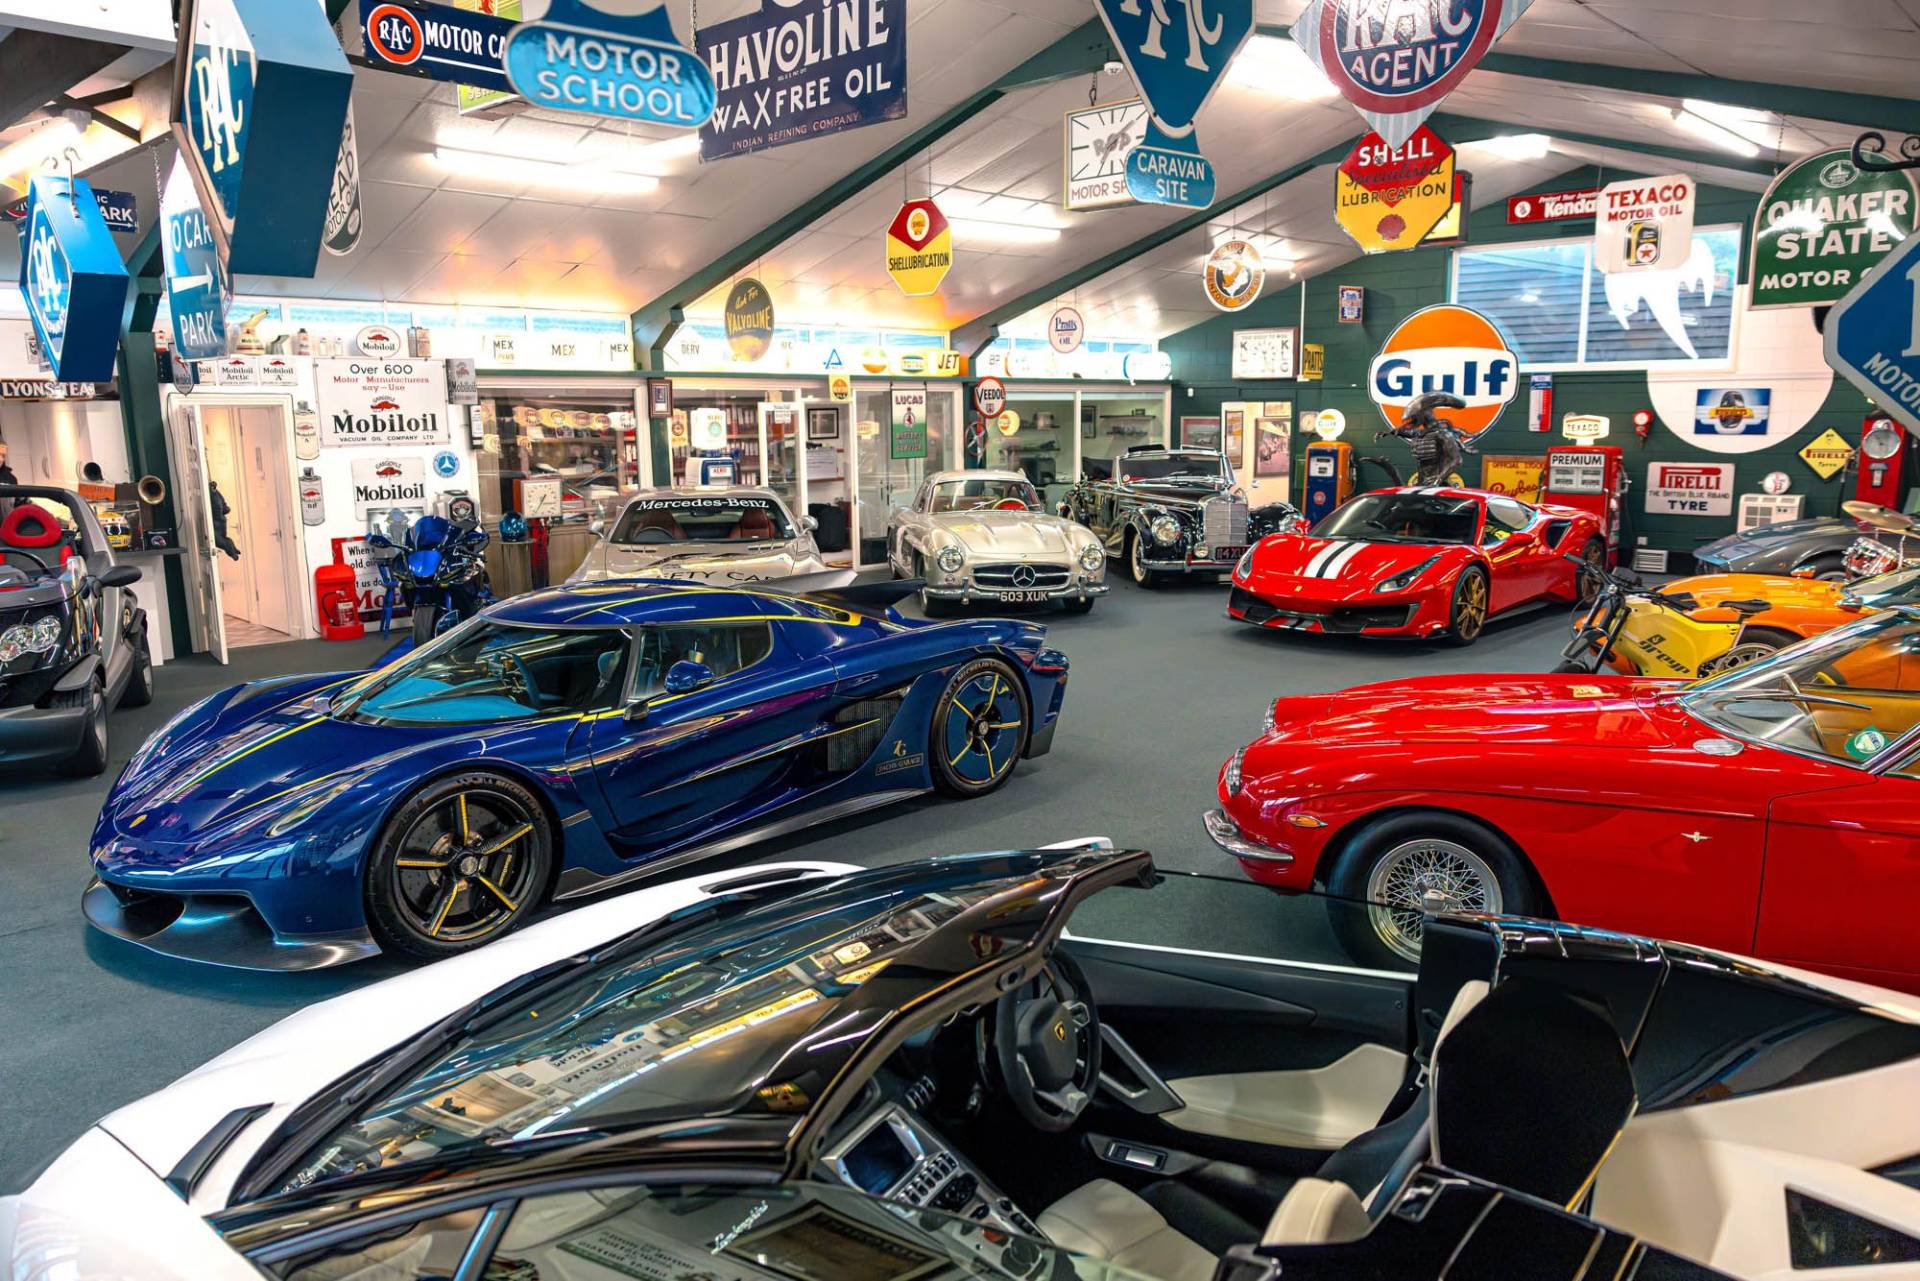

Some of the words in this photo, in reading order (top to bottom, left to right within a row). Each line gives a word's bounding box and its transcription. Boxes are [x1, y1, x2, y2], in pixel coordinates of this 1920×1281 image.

[378, 18, 412, 51] RAC
[425, 20, 483, 55] MOTOR
[708, 0, 890, 91] HAVOLINE
[545, 32, 680, 84] MOTOR
[1350, 41, 1459, 88] AGENT
[845, 62, 892, 99] OIL
[537, 70, 693, 121] SCHOOL
[195, 38, 243, 173] RAC
[732, 135, 763, 151] INDIAN
[768, 124, 808, 142] REFINING
[812, 112, 860, 131] COMPANY
[1358, 137, 1433, 166] SHELL
[1137, 152, 1205, 181] CARAVAN
[1071, 183, 1108, 201] MOTOR
[1156, 178, 1188, 201] SITE
[1342, 182, 1446, 207] LUBRICATION
[1606, 184, 1687, 208] TEXACO
[100, 206, 133, 222] ARK
[1543, 199, 1598, 219] Kenda
[1608, 208, 1654, 221] MOTOR
[1659, 204, 1682, 217] OIL
[1767, 189, 1909, 228] QUAKER
[1776, 227, 1892, 260] STATE
[889, 252, 950, 272] SHELLUBRICATION
[1759, 269, 1851, 290] MOTOR
[179, 310, 218, 346] PARK
[726, 305, 771, 336] VALVOLINE
[362, 342, 395, 351] Mobiloil
[493, 340, 513, 350] MEX
[552, 344, 575, 356] MEX
[610, 343, 629, 352] MEX
[222, 366, 253, 374] Mobiloil
[263, 366, 293, 375] Mobiloil
[350, 364, 378, 375] Over
[384, 364, 413, 375] 600
[938, 354, 959, 370] JET
[333, 376, 359, 384] Motor
[366, 376, 429, 384] Manufacturers
[1376, 358, 1509, 397] Gulf
[62, 382, 95, 397] TEA
[976, 388, 1005, 407] VEEDOL
[895, 395, 923, 405] LUCAS
[332, 413, 438, 434] Mobiloil
[1567, 423, 1599, 433] TEXACO
[1552, 455, 1602, 465] PREMIUM
[1659, 466, 1722, 490] PIRELLI
[356, 483, 425, 502] Mobiloil
[637, 498, 769, 511] Mercedes-Benz
[1668, 500, 1708, 511] TYRE
[348, 546, 371, 558] When
[351, 559, 364, 570] old
[361, 580, 371, 588] us
[1000, 591, 1023, 602] 603
[1026, 591, 1048, 602] XUK
